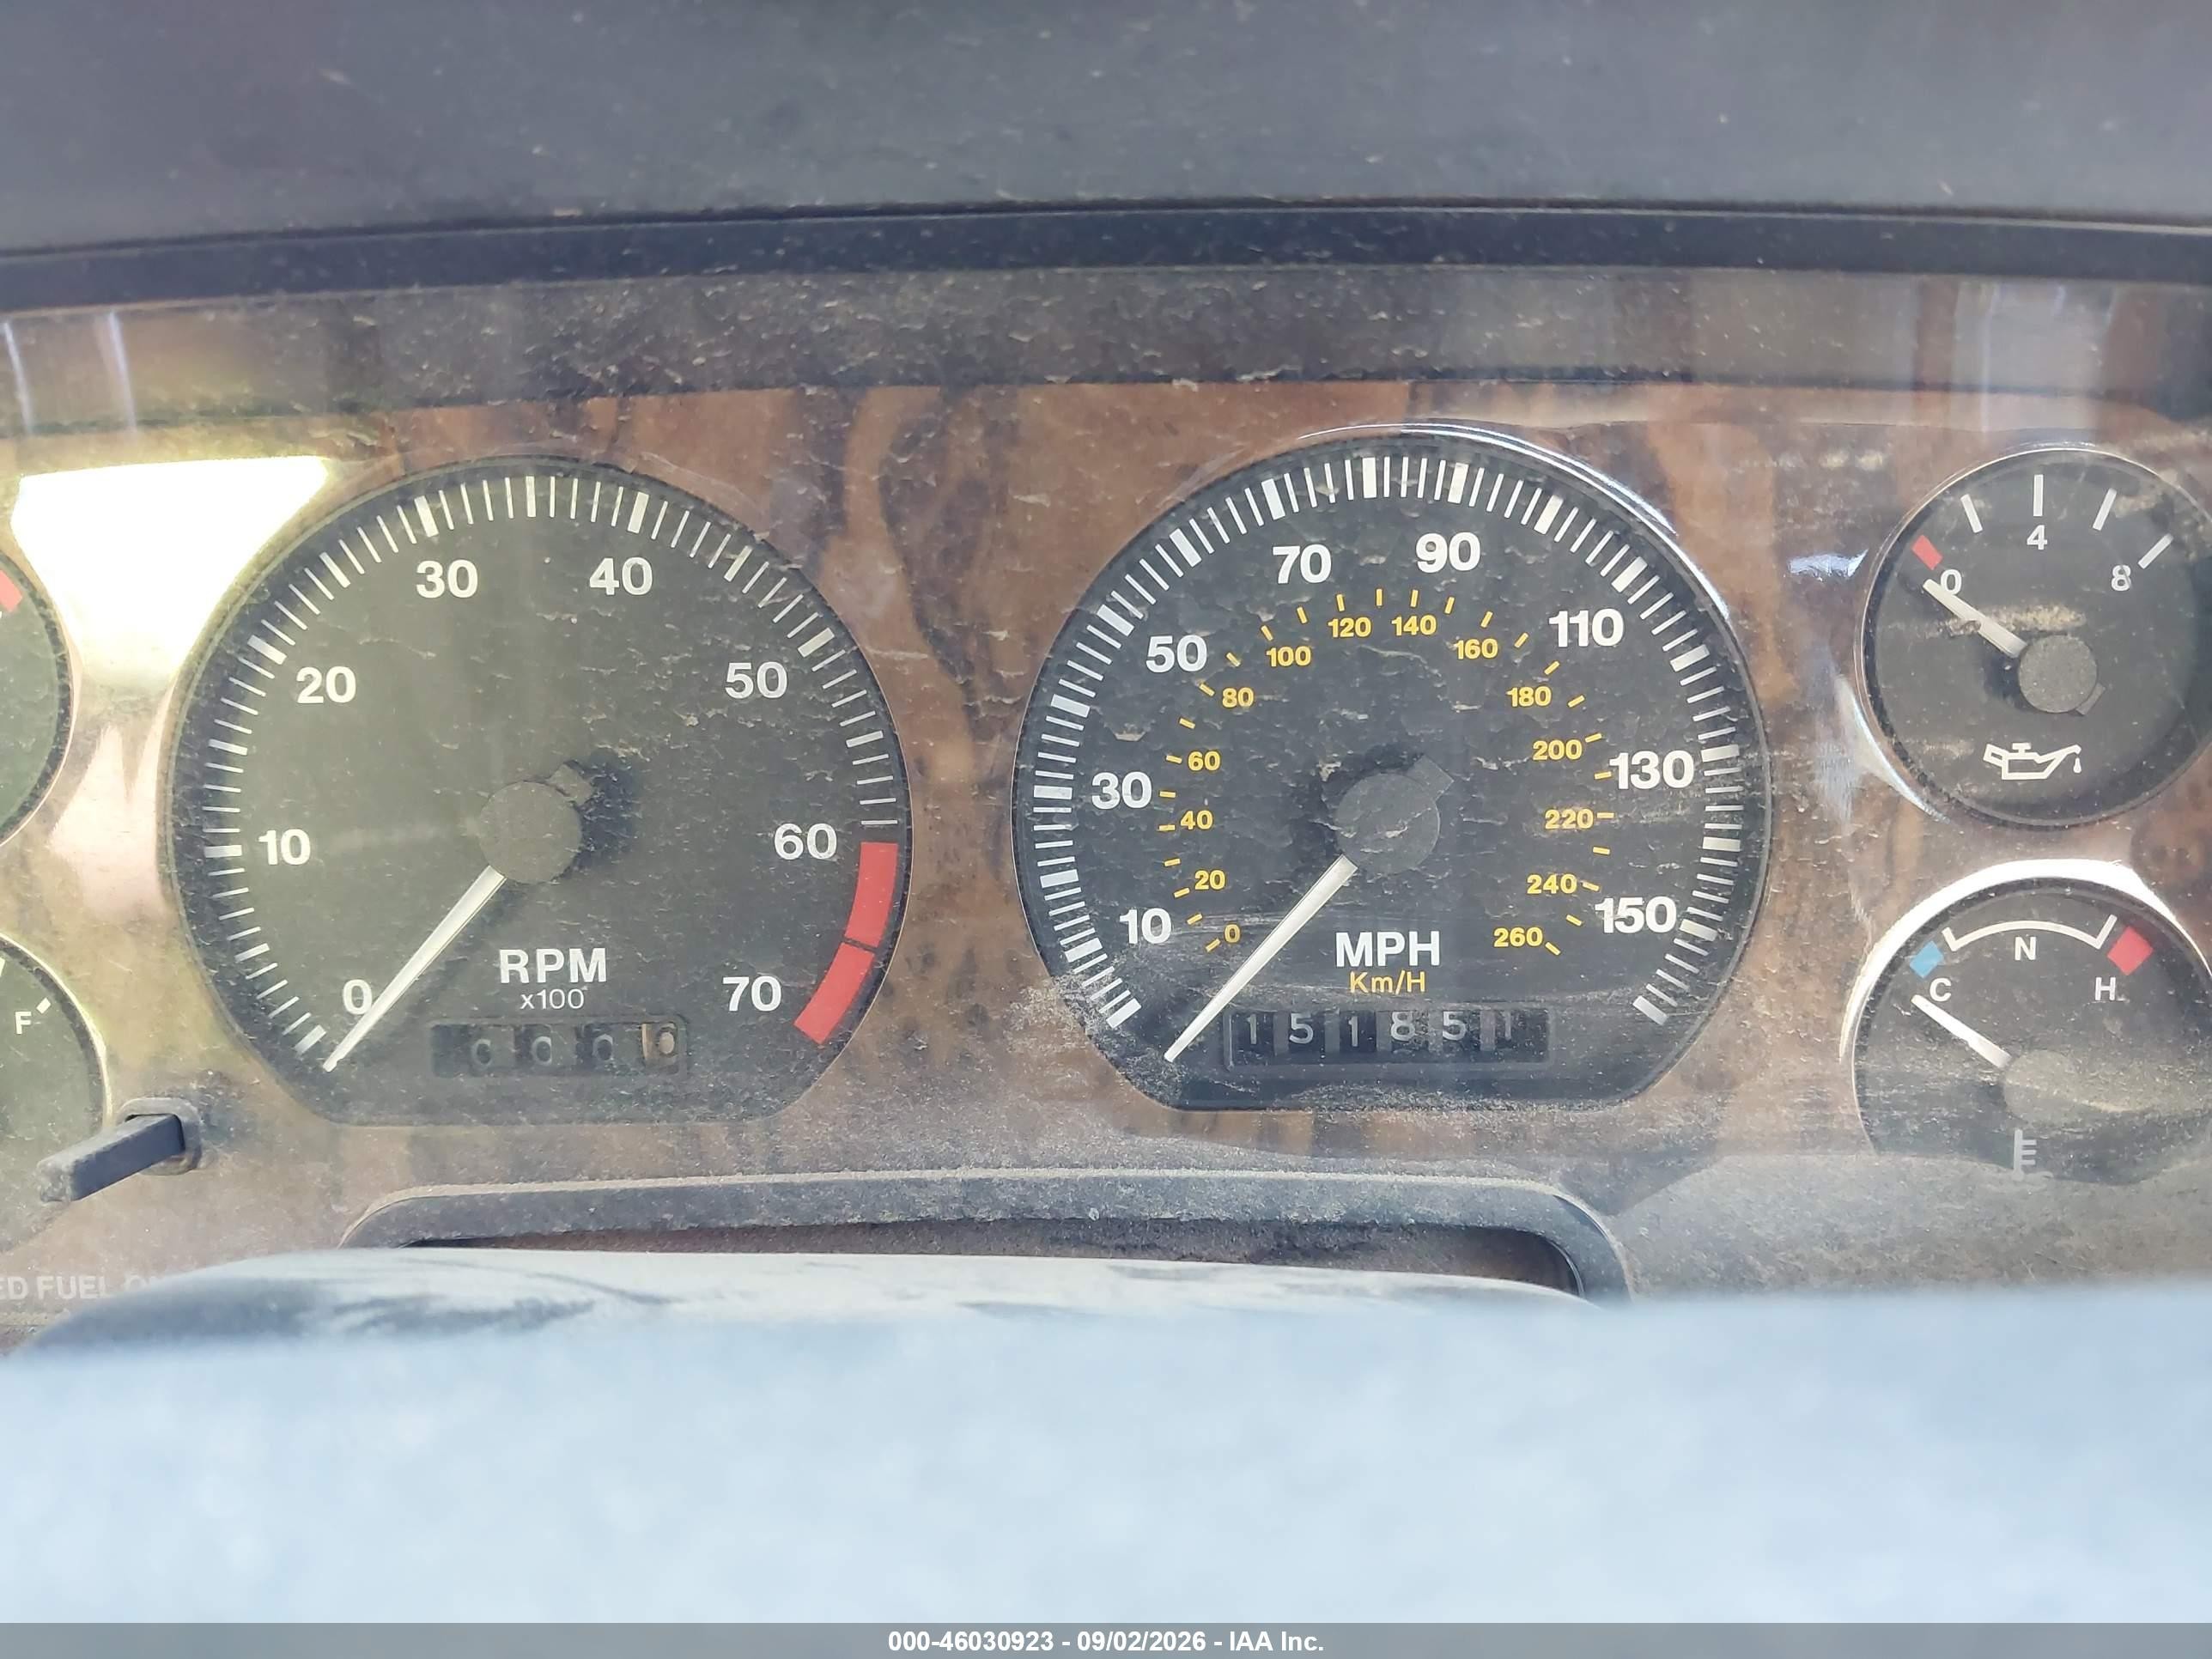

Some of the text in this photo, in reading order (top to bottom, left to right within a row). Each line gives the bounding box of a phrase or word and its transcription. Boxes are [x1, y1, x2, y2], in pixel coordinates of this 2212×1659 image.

[2027, 525, 2048, 550] 4
[1273, 544, 1332, 584] 70
[1416, 532, 1480, 574] 90
[416, 560, 478, 599] 30
[589, 557, 653, 596] 40
[1940, 568, 1962, 594] 0
[2111, 565, 2131, 591] 8
[1328, 617, 1370, 637] 120
[1391, 615, 1436, 635] 140
[1549, 609, 1624, 647] 110
[1146, 635, 1206, 673] 50
[1266, 646, 1310, 666] 100
[1456, 638, 1498, 659] 160
[296, 666, 356, 703] 20
[725, 661, 788, 699] 50
[1222, 688, 1254, 708] 80
[1507, 686, 1551, 706] 180
[1188, 750, 1220, 771] 60
[1533, 739, 1582, 761] 200
[1609, 750, 1693, 788] 130
[1091, 772, 1152, 809] 30
[1180, 810, 1212, 830] 40
[1545, 809, 1593, 829] 220
[258, 830, 311, 865] 10
[774, 823, 836, 860] 60
[1194, 870, 1225, 890] 20
[1527, 874, 1577, 894] 240
[1120, 908, 1172, 944] 10
[1595, 896, 1676, 934] 150
[1224, 924, 1240, 944] 0
[1493, 927, 1543, 947] 260
[1336, 931, 1440, 968] MPH
[2014, 936, 2036, 960] N
[499, 948, 606, 983] RPM
[722, 975, 781, 1012] 70
[1350, 971, 1425, 994] Km/H
[1929, 978, 1951, 1002] C
[2094, 977, 2116, 1000] H
[343, 979, 373, 1015] 0
[520, 988, 585, 1010] x100
[15, 1012, 32, 1034] F
[37, 1276, 111, 1299] FUEL
